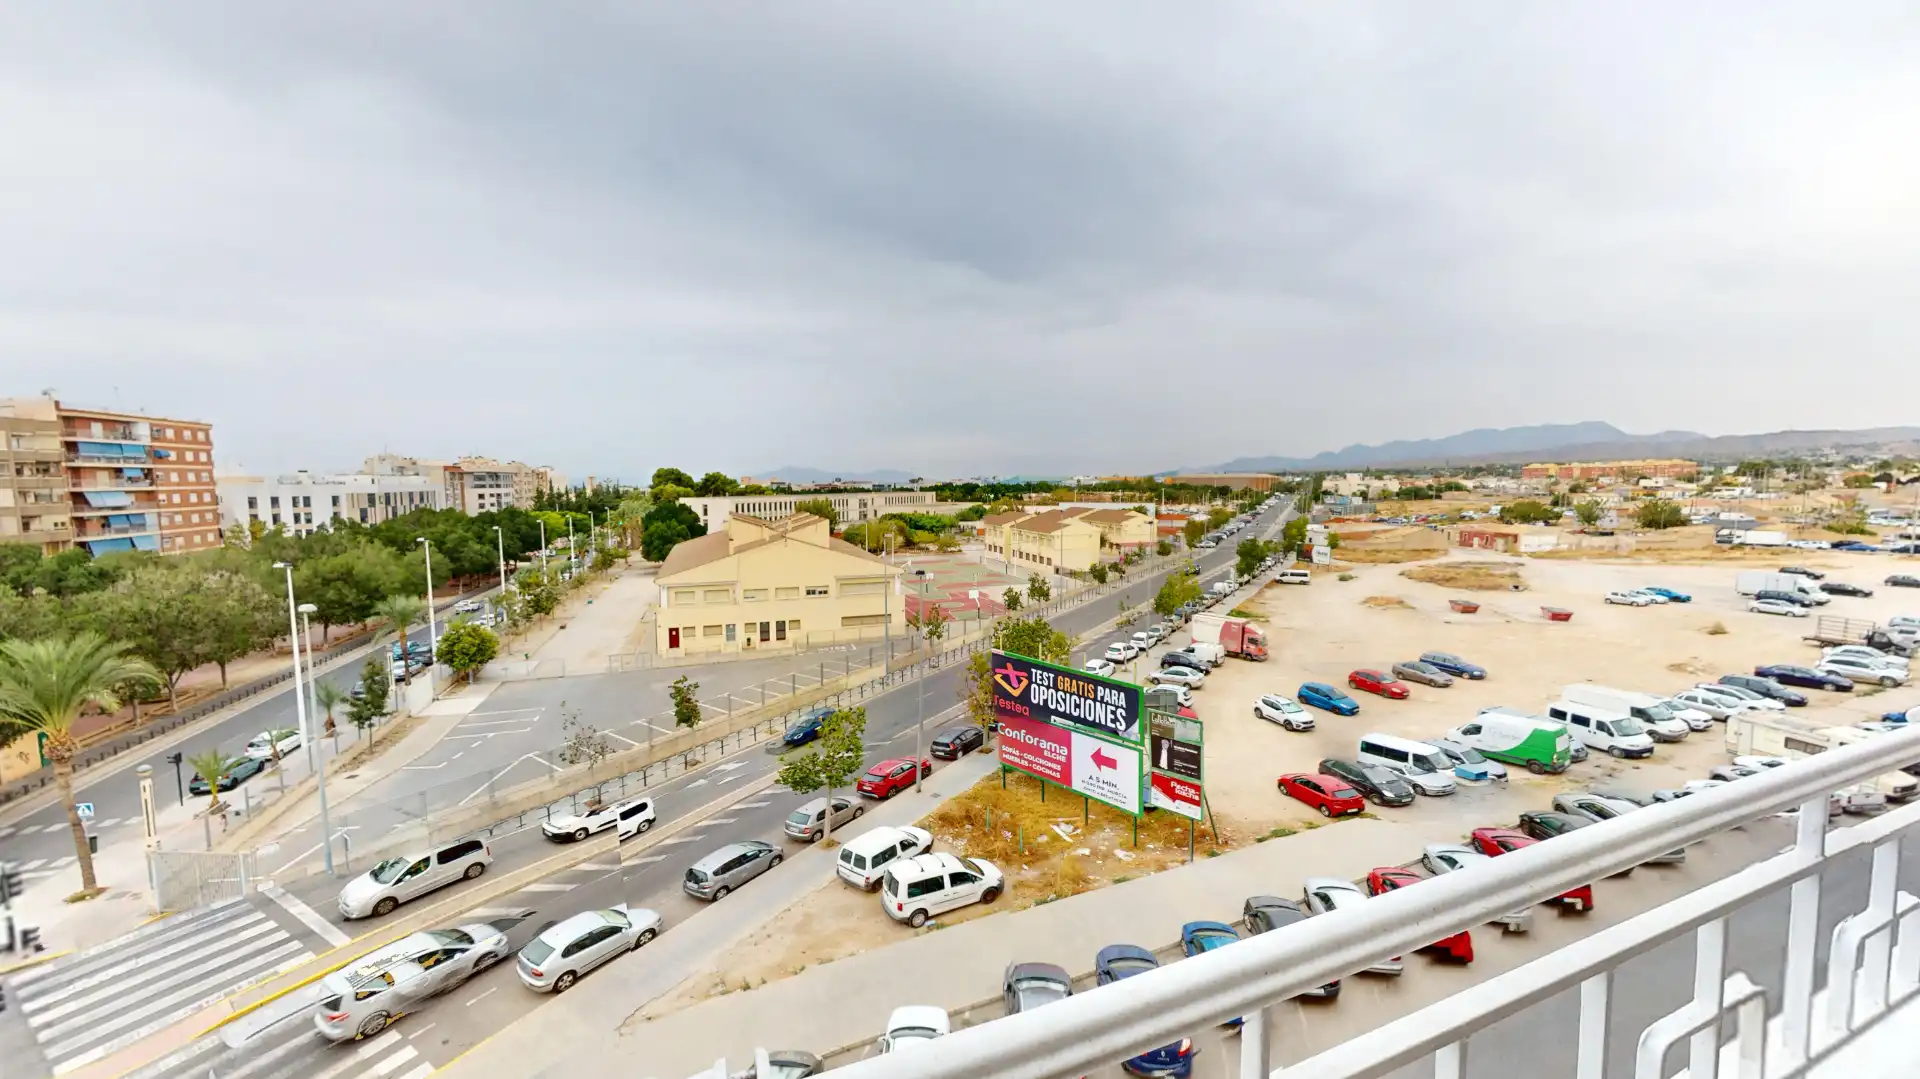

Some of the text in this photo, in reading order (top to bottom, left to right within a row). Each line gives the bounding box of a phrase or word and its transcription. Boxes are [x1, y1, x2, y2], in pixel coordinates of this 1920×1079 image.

[1030, 668, 1127, 709] TEST GRATIS PARA
[993, 694, 1030, 717] Testea
[1030, 683, 1127, 731] OPOSICIONES
[997, 722, 1068, 756] Conforama
[1001, 744, 1062, 771] SOFÁS COLCHONES
[1002, 753, 1061, 779] MUEBLES COCINAS
[1043, 749, 1067, 763] ELCHE
